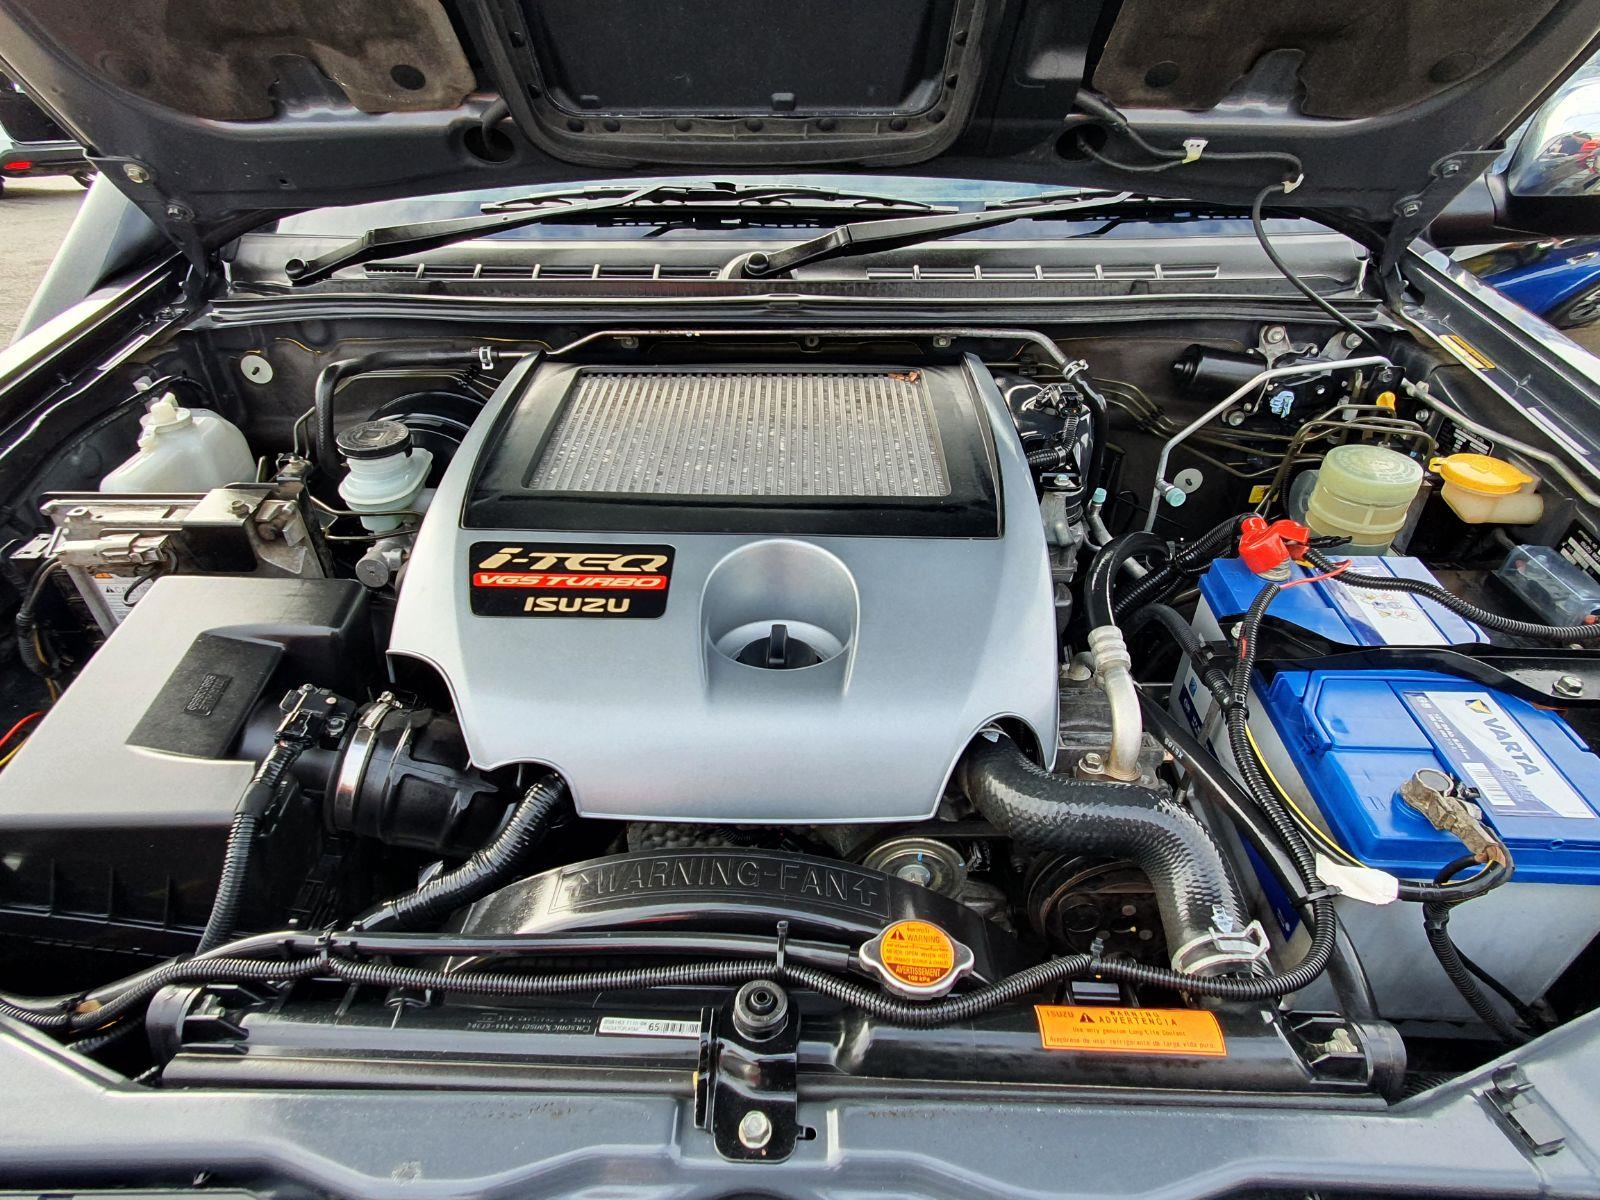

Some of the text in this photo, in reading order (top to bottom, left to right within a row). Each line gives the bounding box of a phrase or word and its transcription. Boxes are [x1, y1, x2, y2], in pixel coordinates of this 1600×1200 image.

[478, 547, 668, 572] i-TEQ
[480, 575, 661, 587] VGS TURBO
[524, 597, 630, 613] ISUZU
[1483, 717, 1541, 775] VARTA
[906, 934, 941, 944] WARNING
[895, 965, 941, 977] AVERTISSEMENT
[1046, 1010, 1075, 1018] ISUZU
[1099, 1016, 1178, 1026] ADVERTENCIA
[648, 1023, 660, 1032] 65
